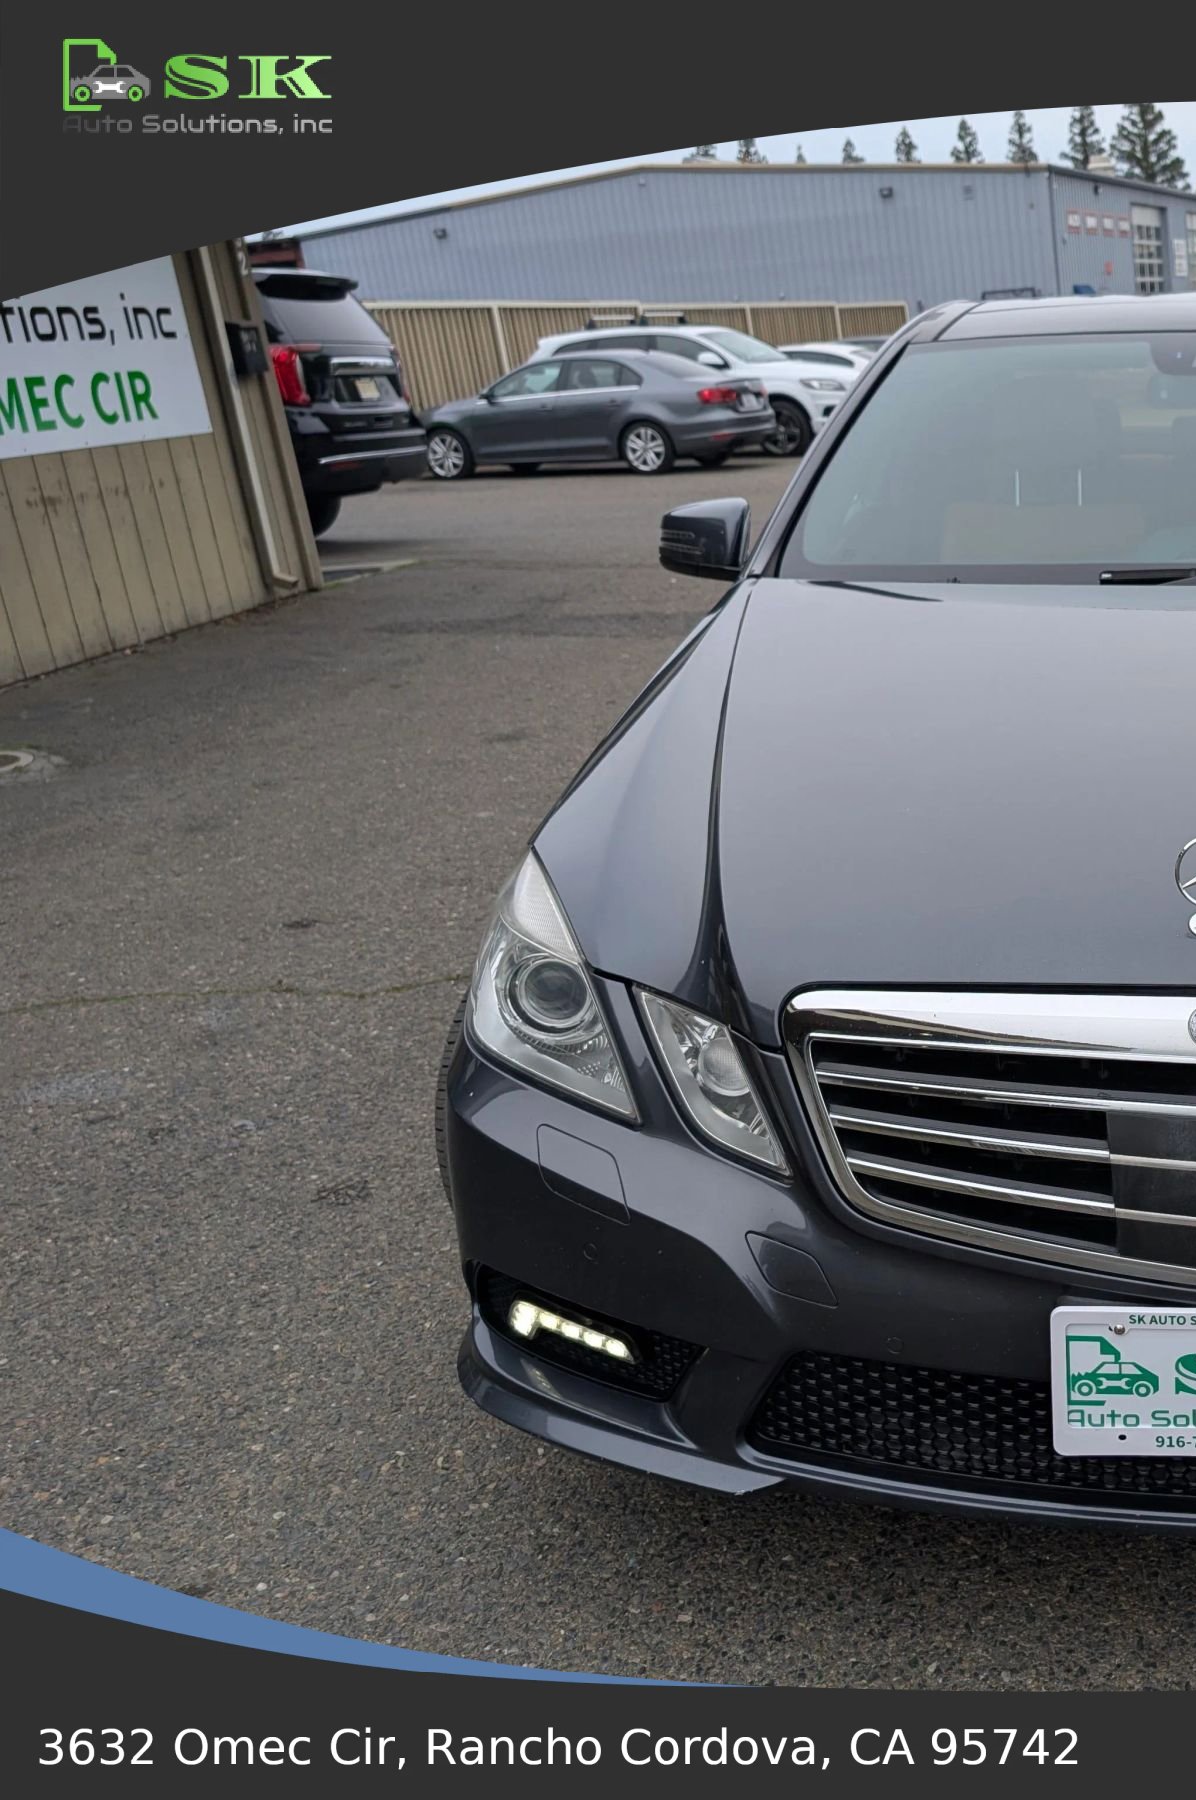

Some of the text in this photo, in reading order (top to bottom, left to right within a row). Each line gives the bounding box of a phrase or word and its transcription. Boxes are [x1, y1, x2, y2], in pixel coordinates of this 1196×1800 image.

[119, 292, 177, 340] inc
[91, 370, 159, 425] CIR
[1128, 1314, 1146, 1325] SK
[1149, 1315, 1187, 1326] AUTO
[1067, 1409, 1140, 1427] Auto
